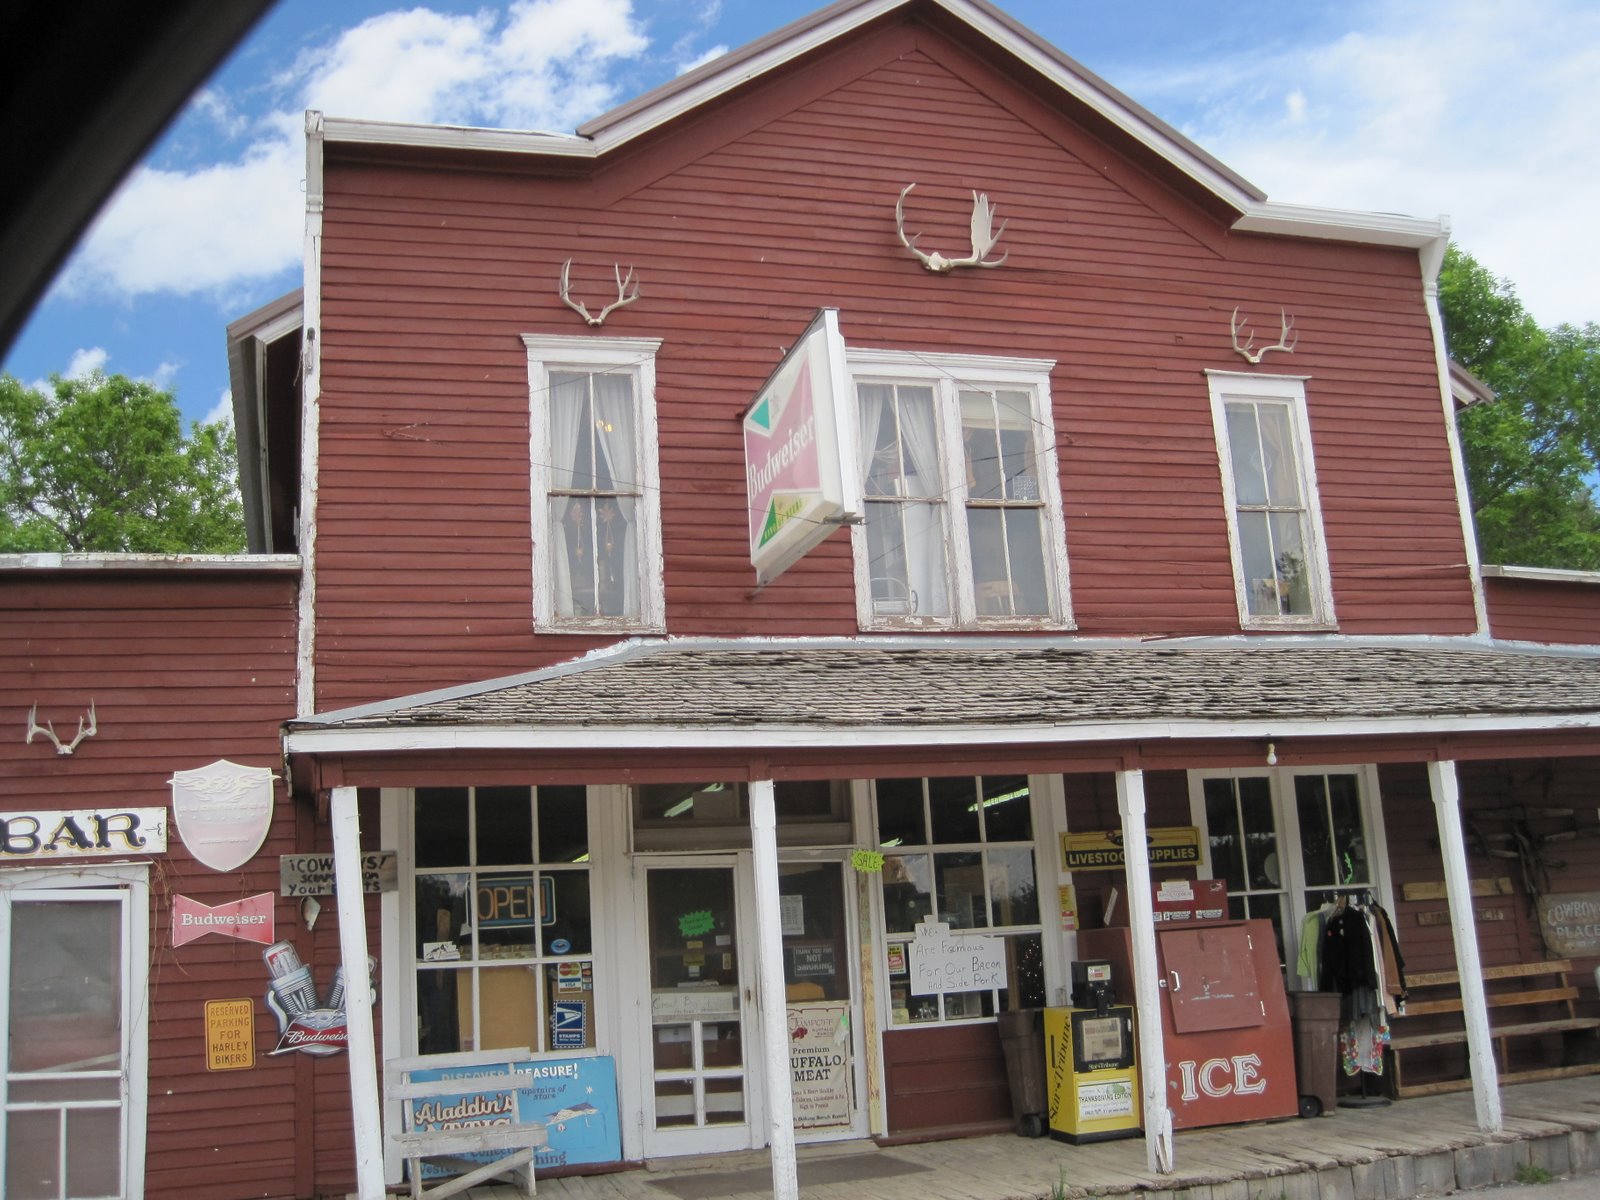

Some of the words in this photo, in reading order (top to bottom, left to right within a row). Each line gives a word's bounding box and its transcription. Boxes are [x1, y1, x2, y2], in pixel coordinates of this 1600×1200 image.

[749, 415, 814, 501] Budweiser
[0, 813, 146, 854] BAR
[855, 852, 880, 869] SALE
[1069, 852, 1126, 865] LIVESTOC
[1150, 848, 1196, 860] UPPLIES
[477, 886, 546, 920] OPEN
[181, 913, 266, 926] Budweiser
[1547, 902, 1600, 926] COWBOY
[916, 943, 936, 957] Are
[941, 940, 984, 954] Famous
[806, 954, 822, 963] NOT
[796, 962, 833, 971] SMOKING
[919, 963, 940, 977] For
[945, 962, 967, 975] Our
[972, 956, 1001, 973] Bacon
[947, 977, 969, 989] Side
[210, 1005, 249, 1017] RESERVED
[210, 1017, 250, 1029] PARKING
[220, 1029, 241, 1040] FOR
[286, 1030, 351, 1044] Budweise
[212, 1041, 249, 1053] HARLEY
[792, 1046, 830, 1054] Premium
[215, 1053, 248, 1065] BIKERS
[790, 1054, 842, 1069] UFFALO
[514, 1062, 578, 1080] REASURE!
[794, 1068, 831, 1082] MEAT
[1178, 1053, 1267, 1101] ICE
[415, 1093, 513, 1125] Aladdin's
